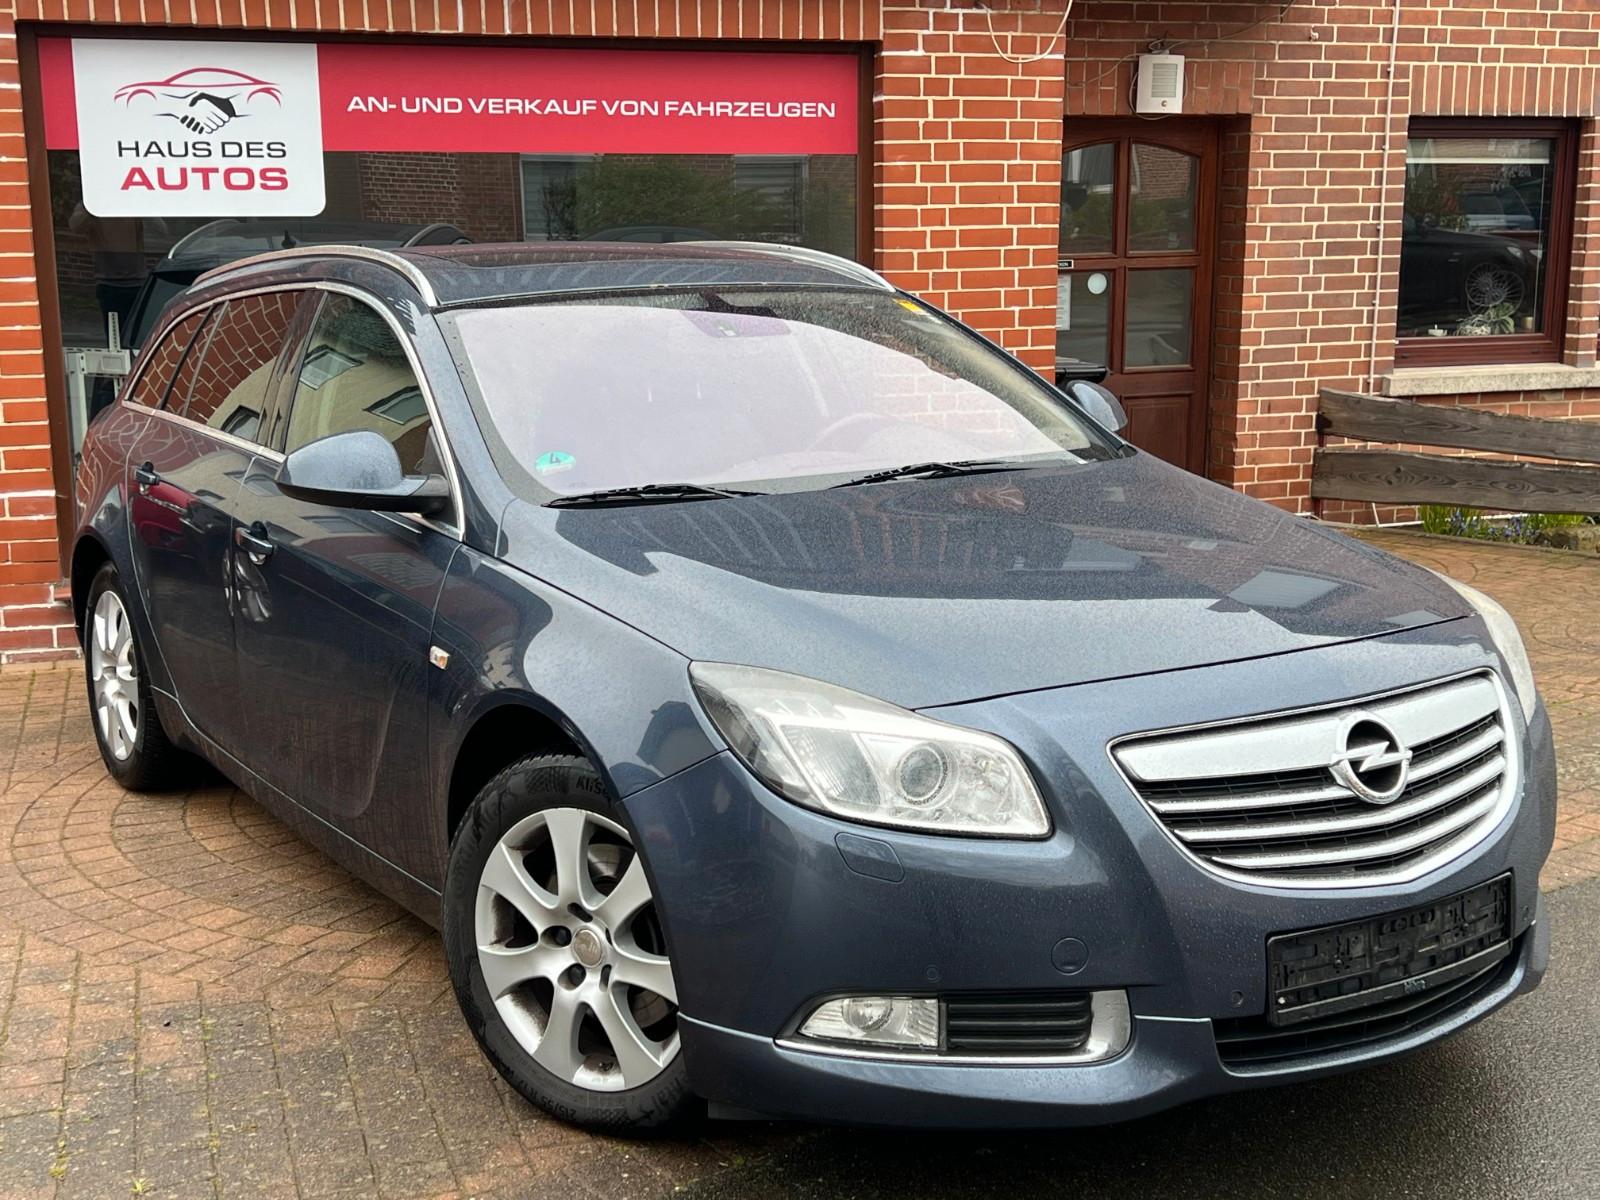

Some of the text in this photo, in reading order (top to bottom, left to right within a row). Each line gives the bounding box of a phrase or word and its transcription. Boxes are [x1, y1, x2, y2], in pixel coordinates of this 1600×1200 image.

[347, 96, 836, 118] AN- UND VERKAUF VON FAHRZEUGEN
[117, 140, 287, 159] HAUS DES
[120, 166, 289, 191] AUTOS
